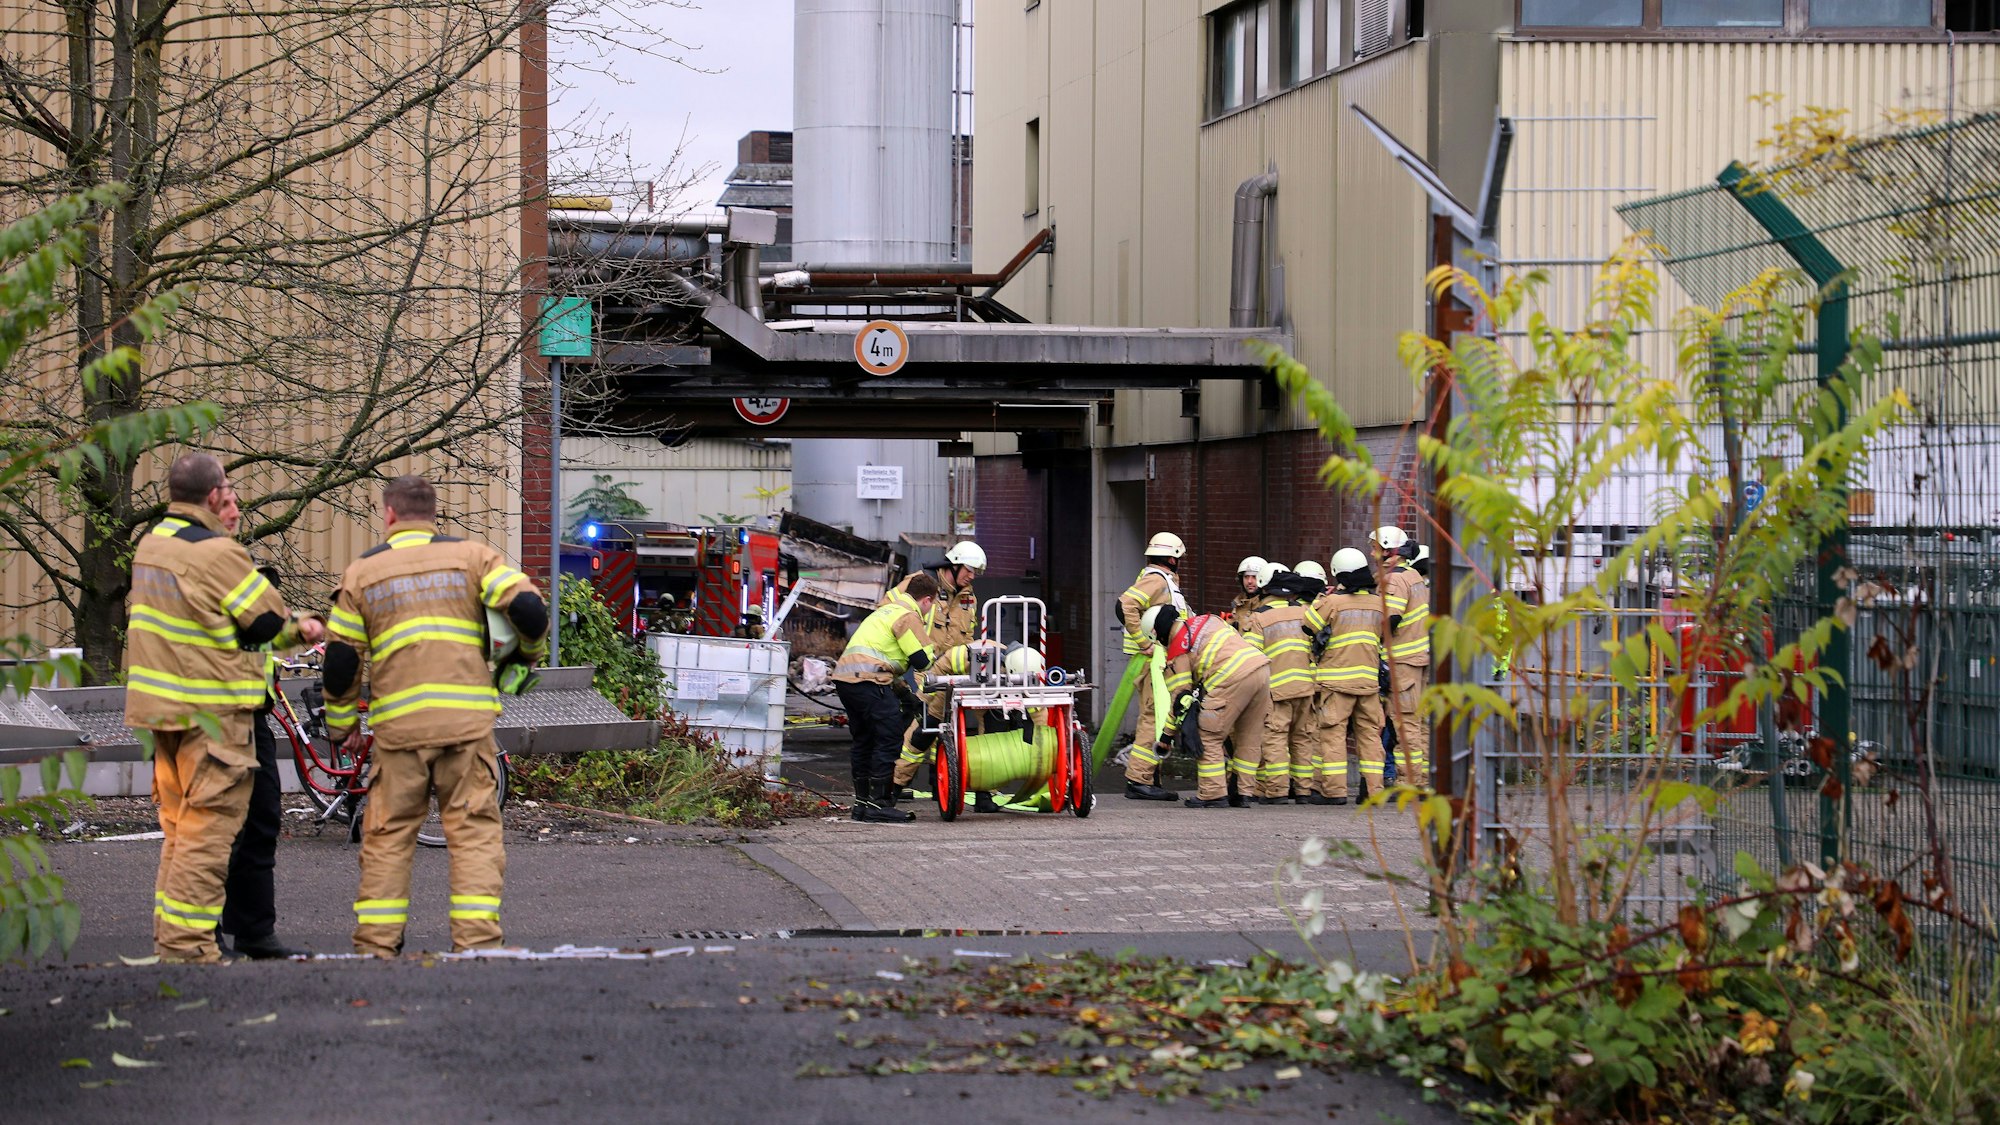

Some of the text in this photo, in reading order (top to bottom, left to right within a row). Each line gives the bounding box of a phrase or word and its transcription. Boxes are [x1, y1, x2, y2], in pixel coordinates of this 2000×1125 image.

[871, 337, 893, 356] 4 m
[364, 571, 467, 604] FEUERWEHR
